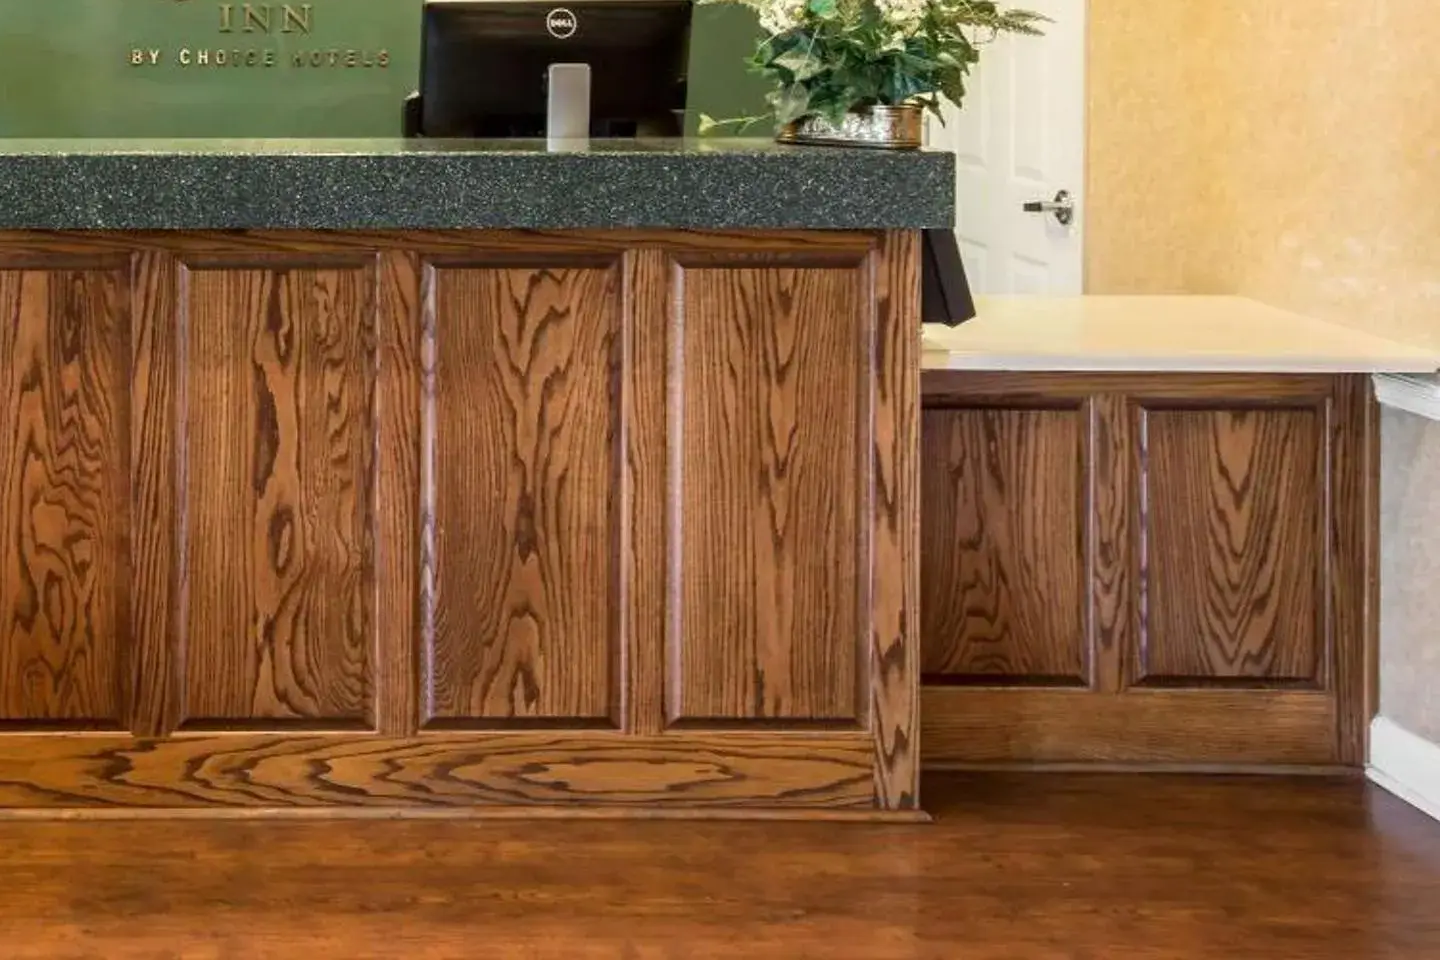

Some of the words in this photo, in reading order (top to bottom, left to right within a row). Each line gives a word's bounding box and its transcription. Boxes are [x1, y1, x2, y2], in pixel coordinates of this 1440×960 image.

[219, 3, 312, 34] INN
[130, 48, 160, 66] BY
[179, 46, 276, 67] CHOICE
